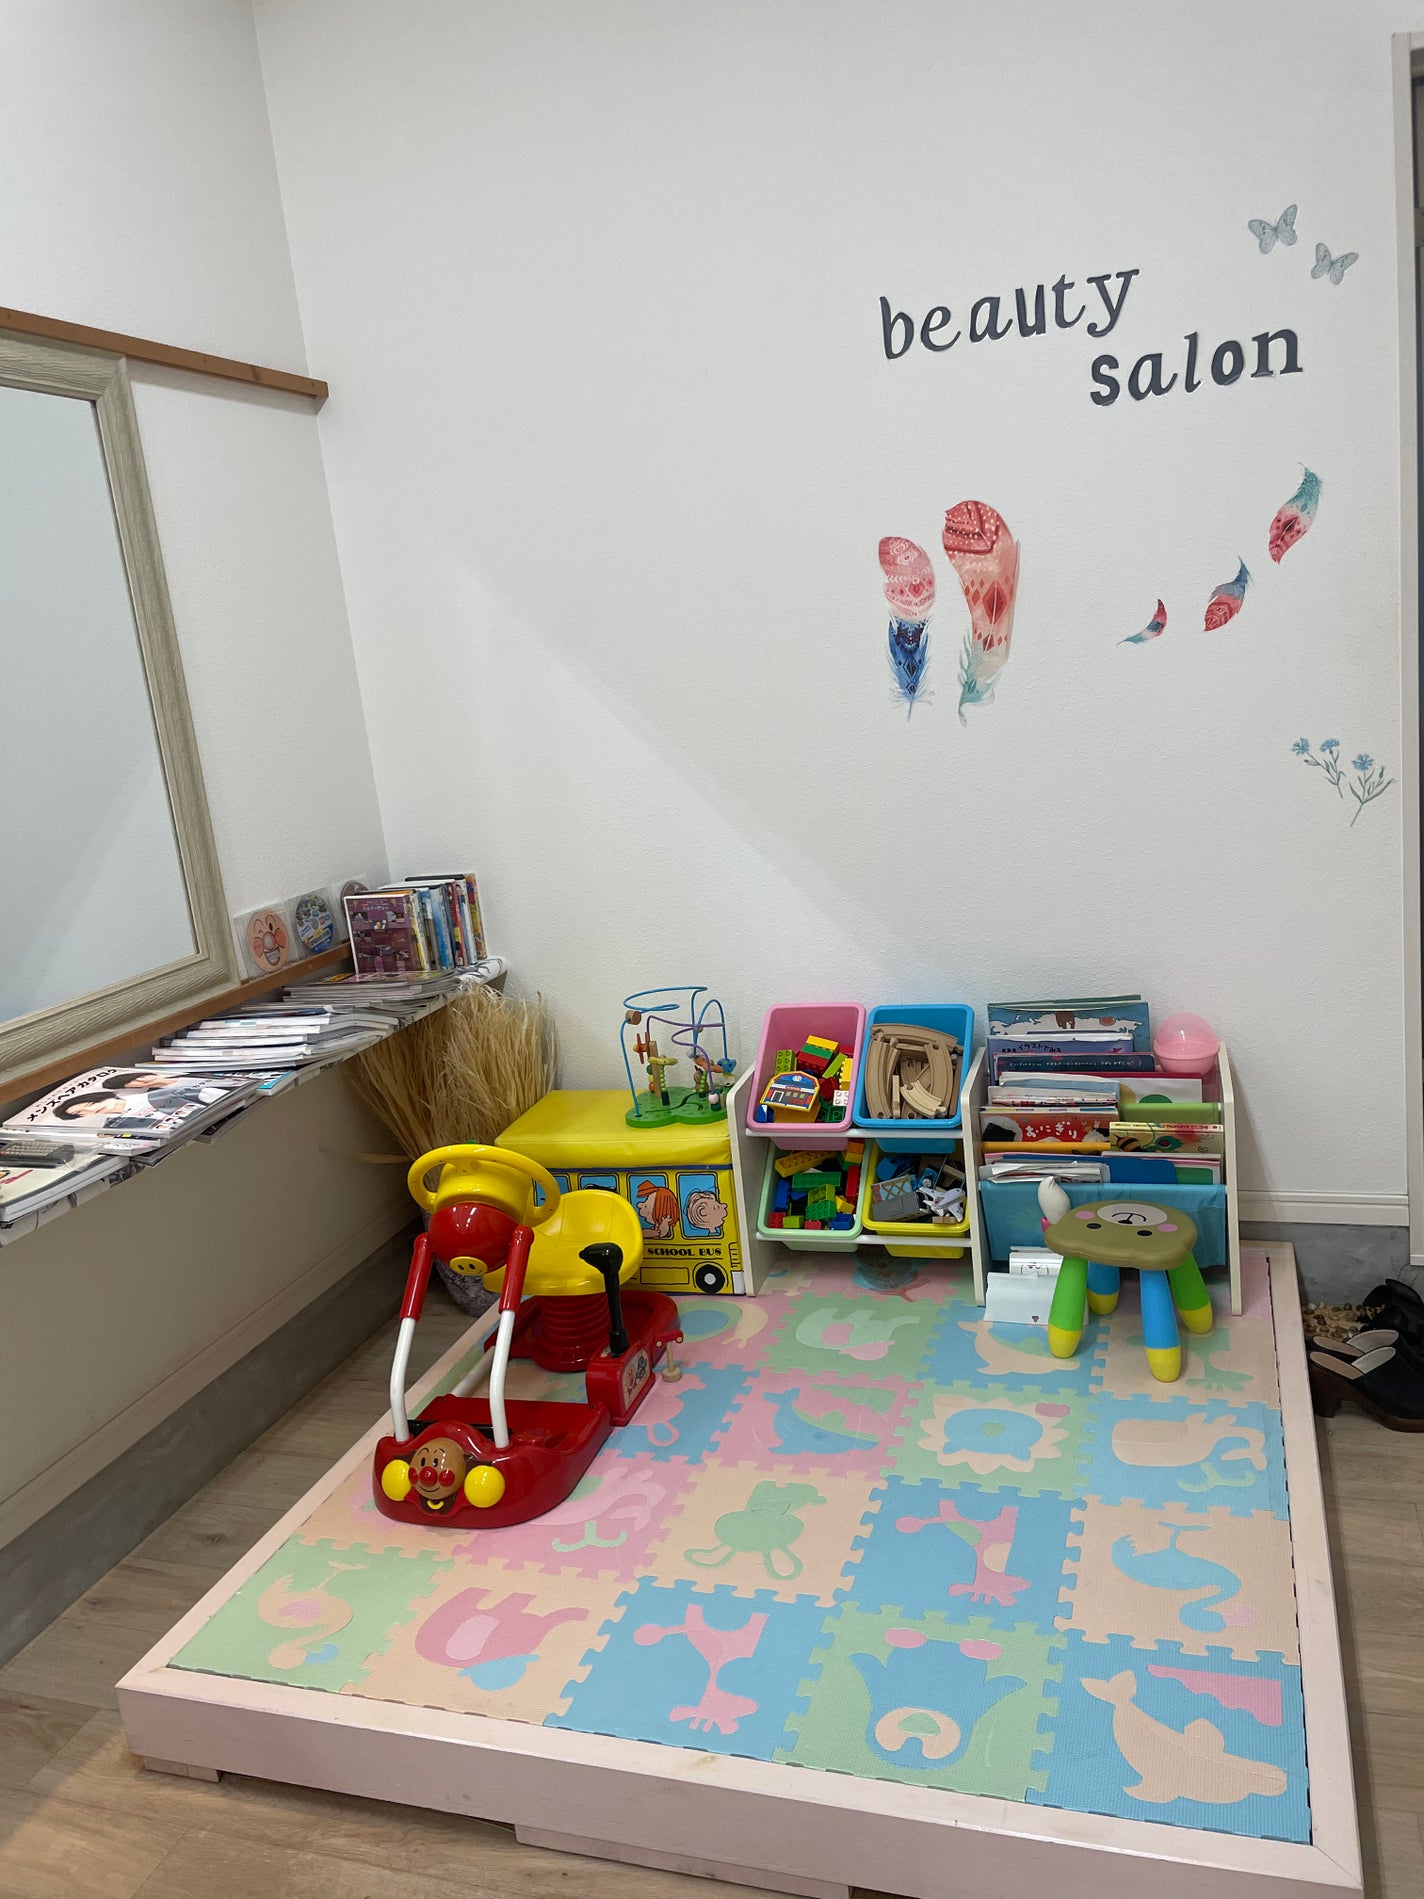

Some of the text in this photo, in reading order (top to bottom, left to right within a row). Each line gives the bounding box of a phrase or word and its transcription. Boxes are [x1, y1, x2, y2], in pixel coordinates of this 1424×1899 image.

[879, 268, 1140, 360] beauty
[1090, 328, 1303, 406] salon
[1025, 1121, 1078, 1139] おにぎり
[647, 1248, 722, 1257] SCHOOL BUS
